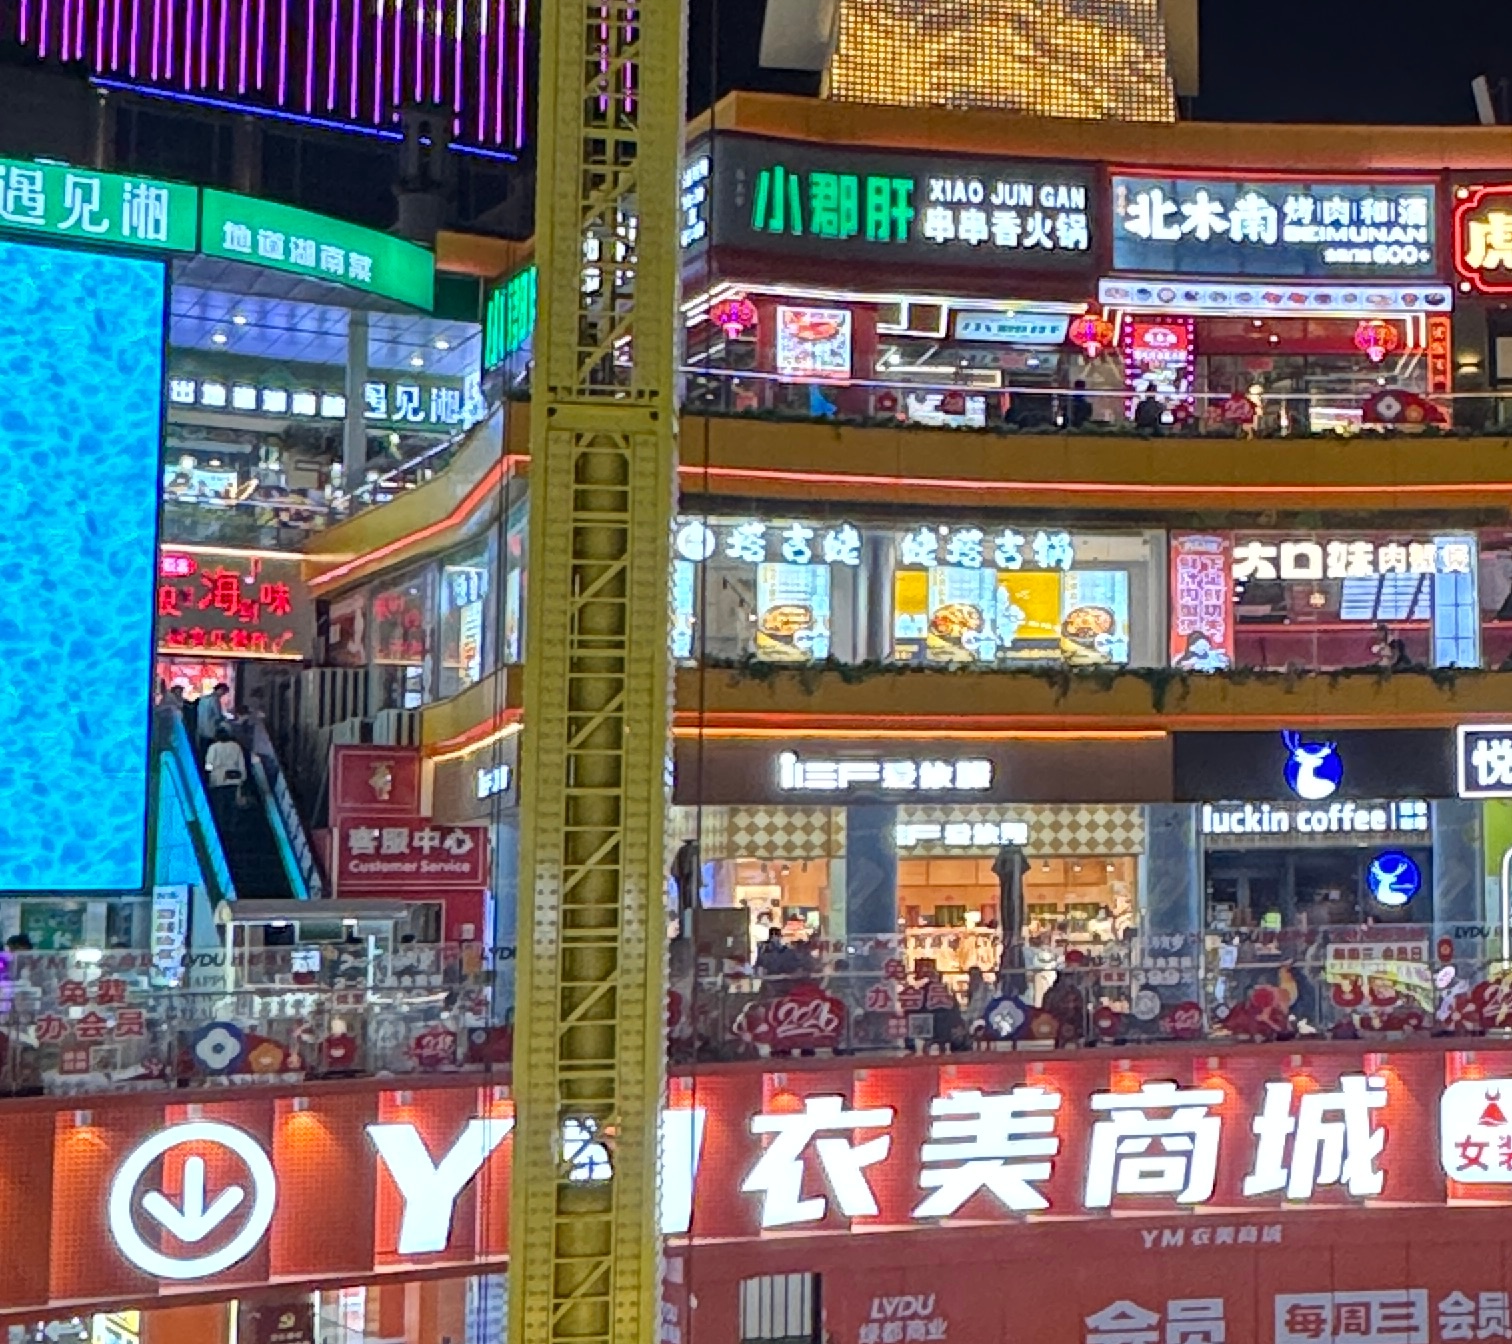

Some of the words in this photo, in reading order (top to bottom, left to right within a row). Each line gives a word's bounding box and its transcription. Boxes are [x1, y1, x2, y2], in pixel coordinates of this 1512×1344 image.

[0, 165, 169, 241] 遇见湘
[752, 164, 915, 243] 小郡肝
[929, 177, 984, 206] XIAO
[991, 181, 1034, 208] JUN
[1040, 184, 1086, 210] GAN
[923, 207, 1090, 252] 串串香火锅
[1124, 187, 1278, 245] 北木南
[1283, 225, 1428, 244] BEIMUNAN
[222, 220, 373, 283] 地道湖南菜
[1203, 804, 1292, 834] luckin
[1297, 801, 1386, 833] coffee
[348, 826, 474, 856] 客服中心
[349, 860, 417, 874] Customer
[420, 860, 471, 874] Service
[58, 978, 128, 1006] 免费
[866, 986, 952, 1009] 办会员
[36, 1008, 145, 1040] 办会员
[742, 1074, 1390, 1228] 衣美商城
[1141, 1228, 1185, 1250] YM
[1190, 1224, 1283, 1246] 衣美商城
[871, 1293, 936, 1320] LVDU
[1285, 1301, 1422, 1338] 每周三
